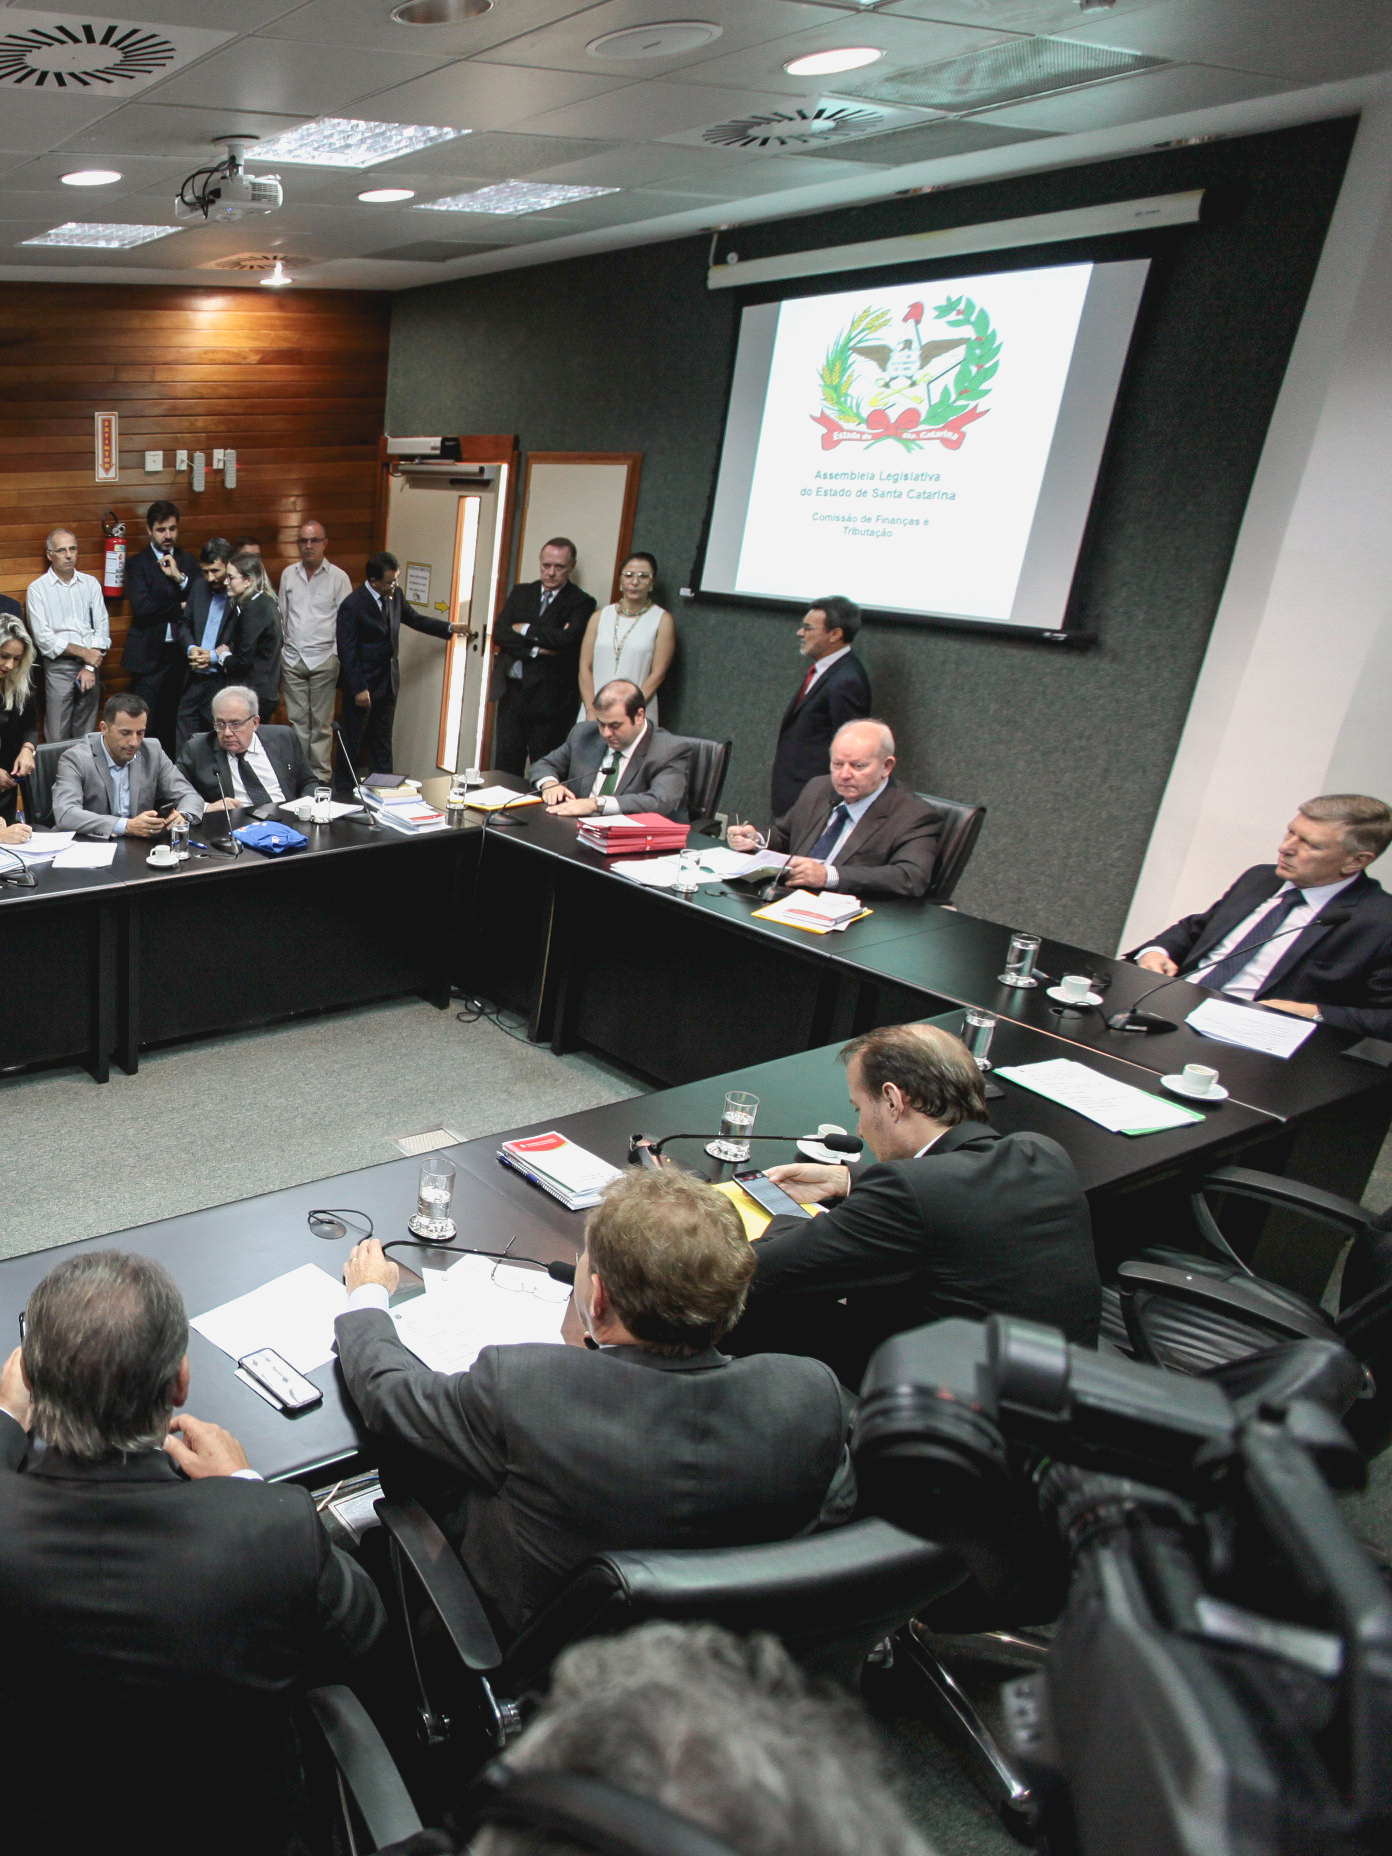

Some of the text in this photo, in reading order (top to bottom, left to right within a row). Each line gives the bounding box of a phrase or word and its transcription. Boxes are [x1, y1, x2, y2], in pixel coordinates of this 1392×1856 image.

[813, 469, 942, 484] Assembleia Legislativa
[799, 486, 957, 501] do Estado de Santa Catarina
[811, 511, 859, 523] Comissão
[859, 514, 873, 524] de
[874, 514, 921, 528] Finanças
[842, 525, 894, 539] Tributação
